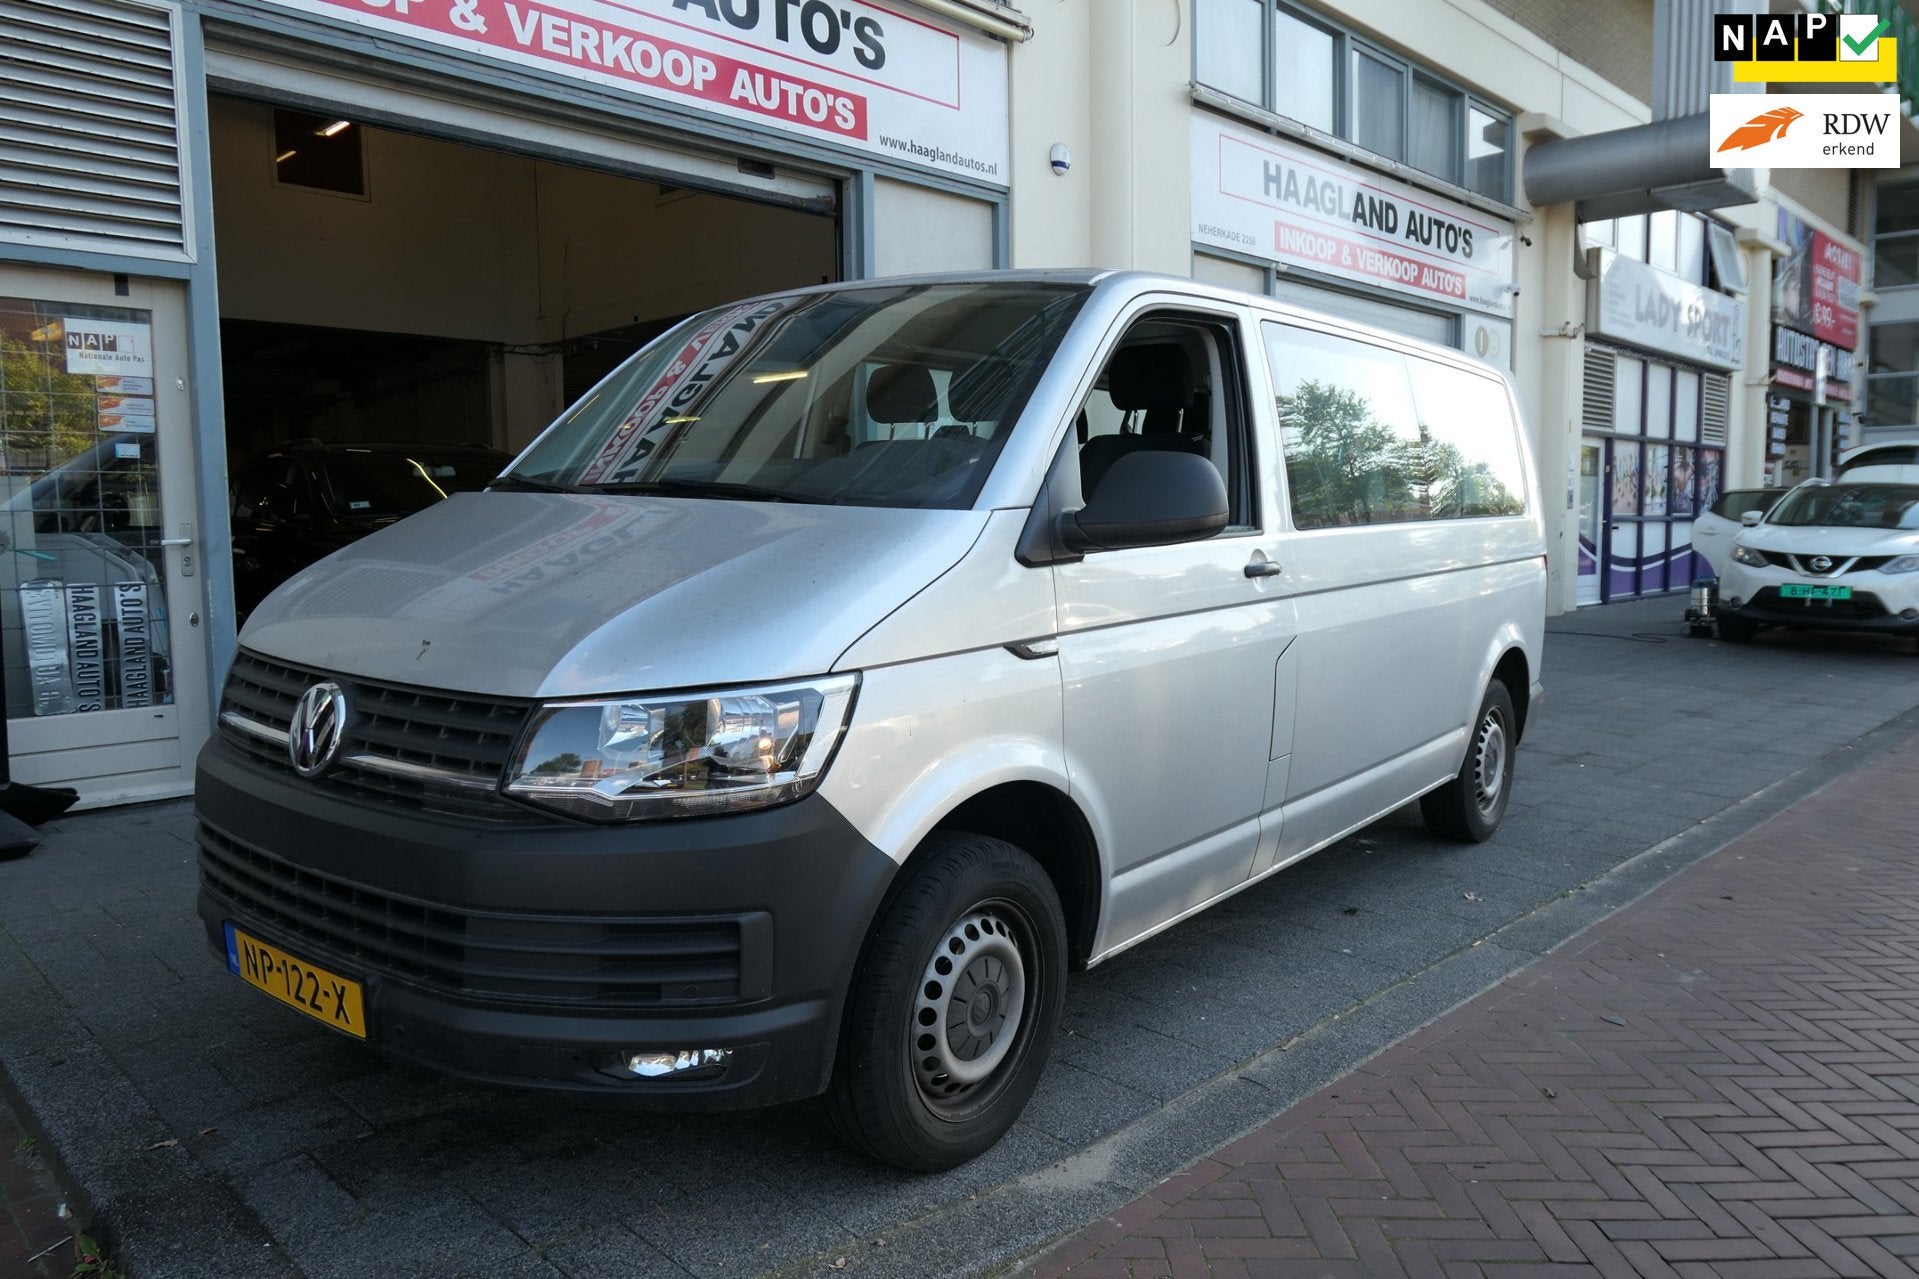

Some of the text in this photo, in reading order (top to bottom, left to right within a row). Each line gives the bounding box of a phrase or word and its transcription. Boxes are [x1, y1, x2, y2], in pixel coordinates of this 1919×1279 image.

[449, 0, 856, 131] & VERKOOP AUTO'S
[878, 133, 998, 177] www.haaglandautos.nl
[1198, 223, 1241, 242] NEHERKADE
[1262, 159, 1474, 259] HAAGLAND AUTO'S
[1279, 225, 1464, 296] INKOOP & VERKOOP AUTO'S
[1634, 283, 1683, 333] LADY
[1687, 303, 1732, 348] SPORT
[79, 351, 113, 361] Nationale
[115, 353, 131, 363] Auto
[71, 585, 102, 712] HAAGLAND AUTO'S
[118, 584, 149, 707] HAAGLAND AUTO'S
[243, 939, 351, 1025] NP-122-X
